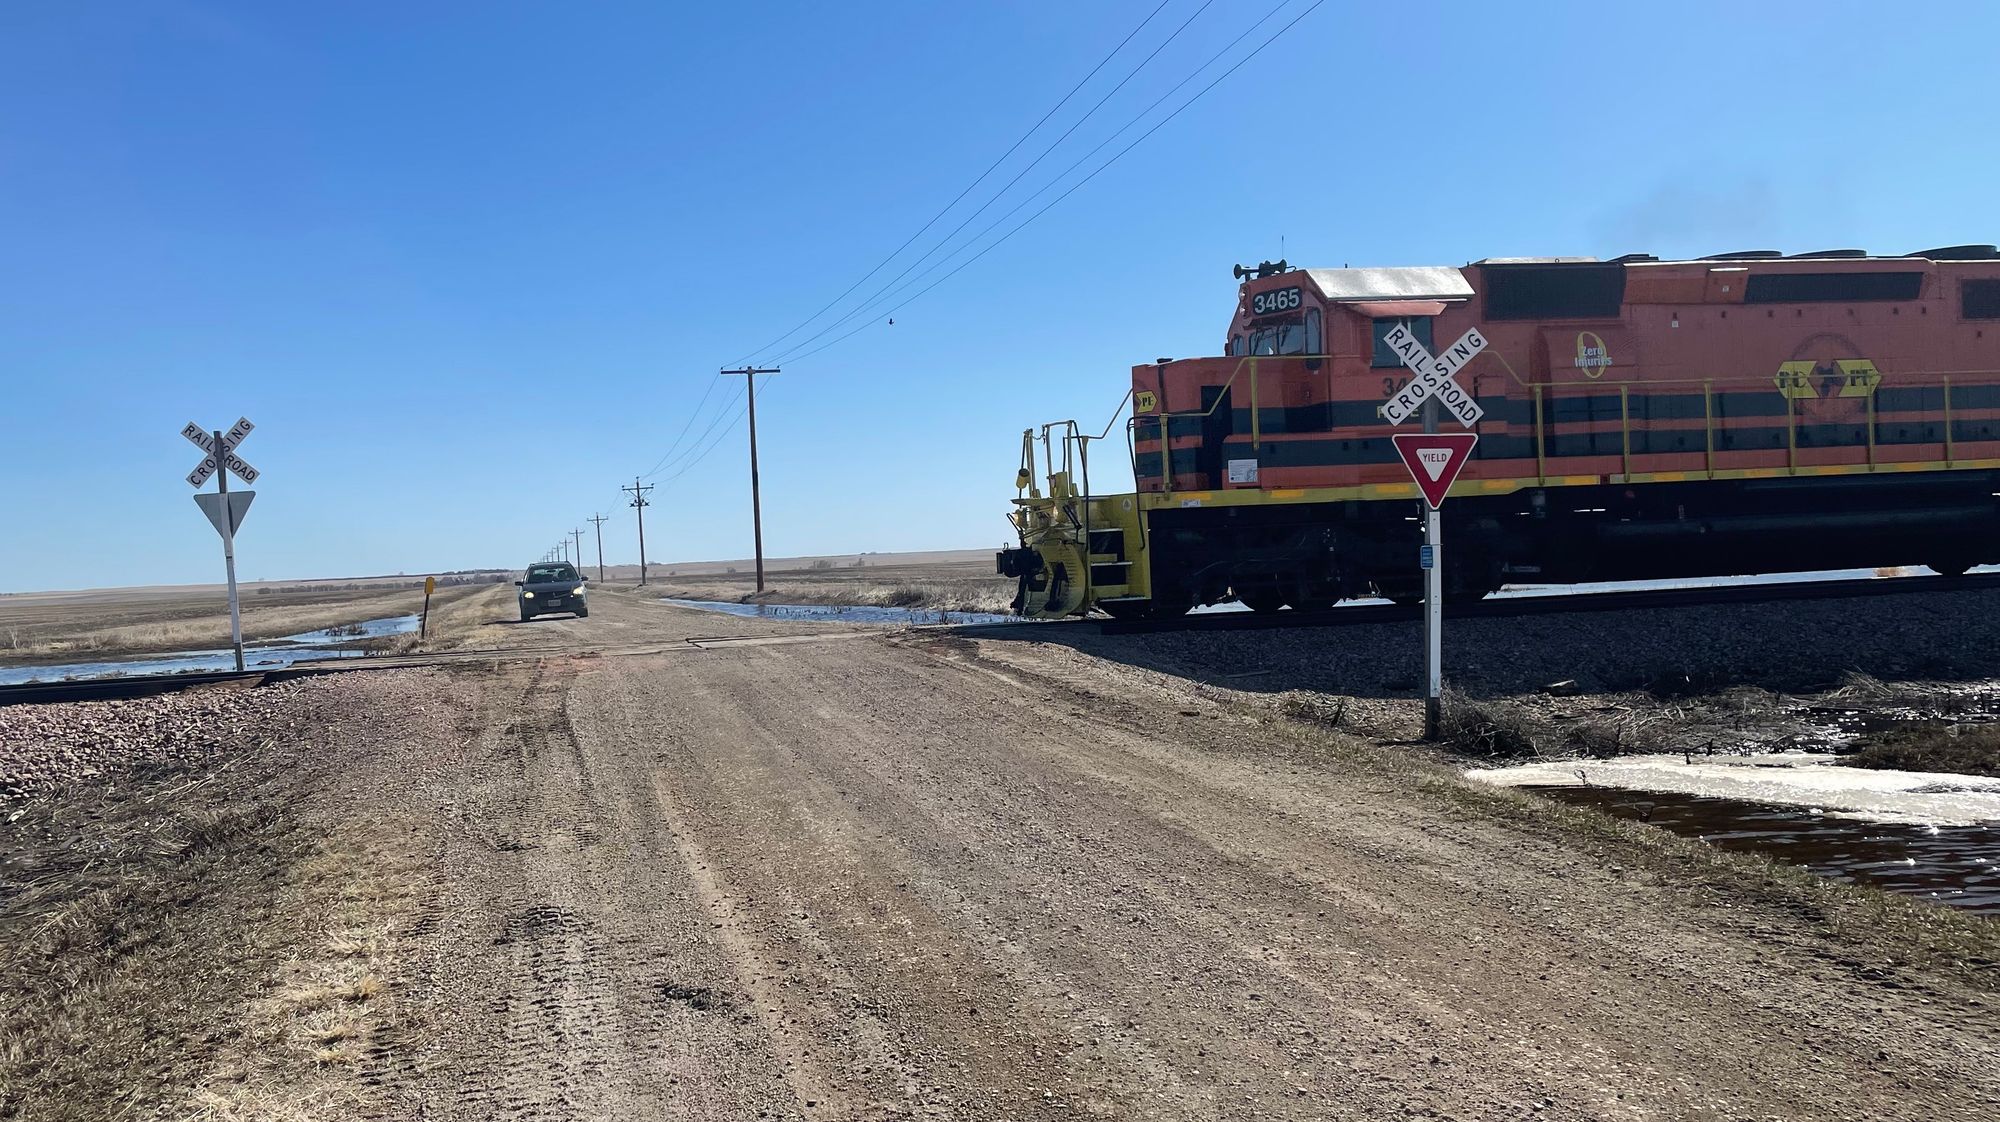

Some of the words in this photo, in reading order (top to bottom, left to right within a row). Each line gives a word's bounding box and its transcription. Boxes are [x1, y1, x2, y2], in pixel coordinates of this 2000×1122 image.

[1254, 288, 1300, 314] 3465
[1582, 346, 1604, 356] Zero
[1574, 356, 1613, 368] Injuries
[1387, 333, 1482, 420] CROSSING
[190, 420, 251, 485] CROSING
[1422, 453, 1447, 463] YIELD
